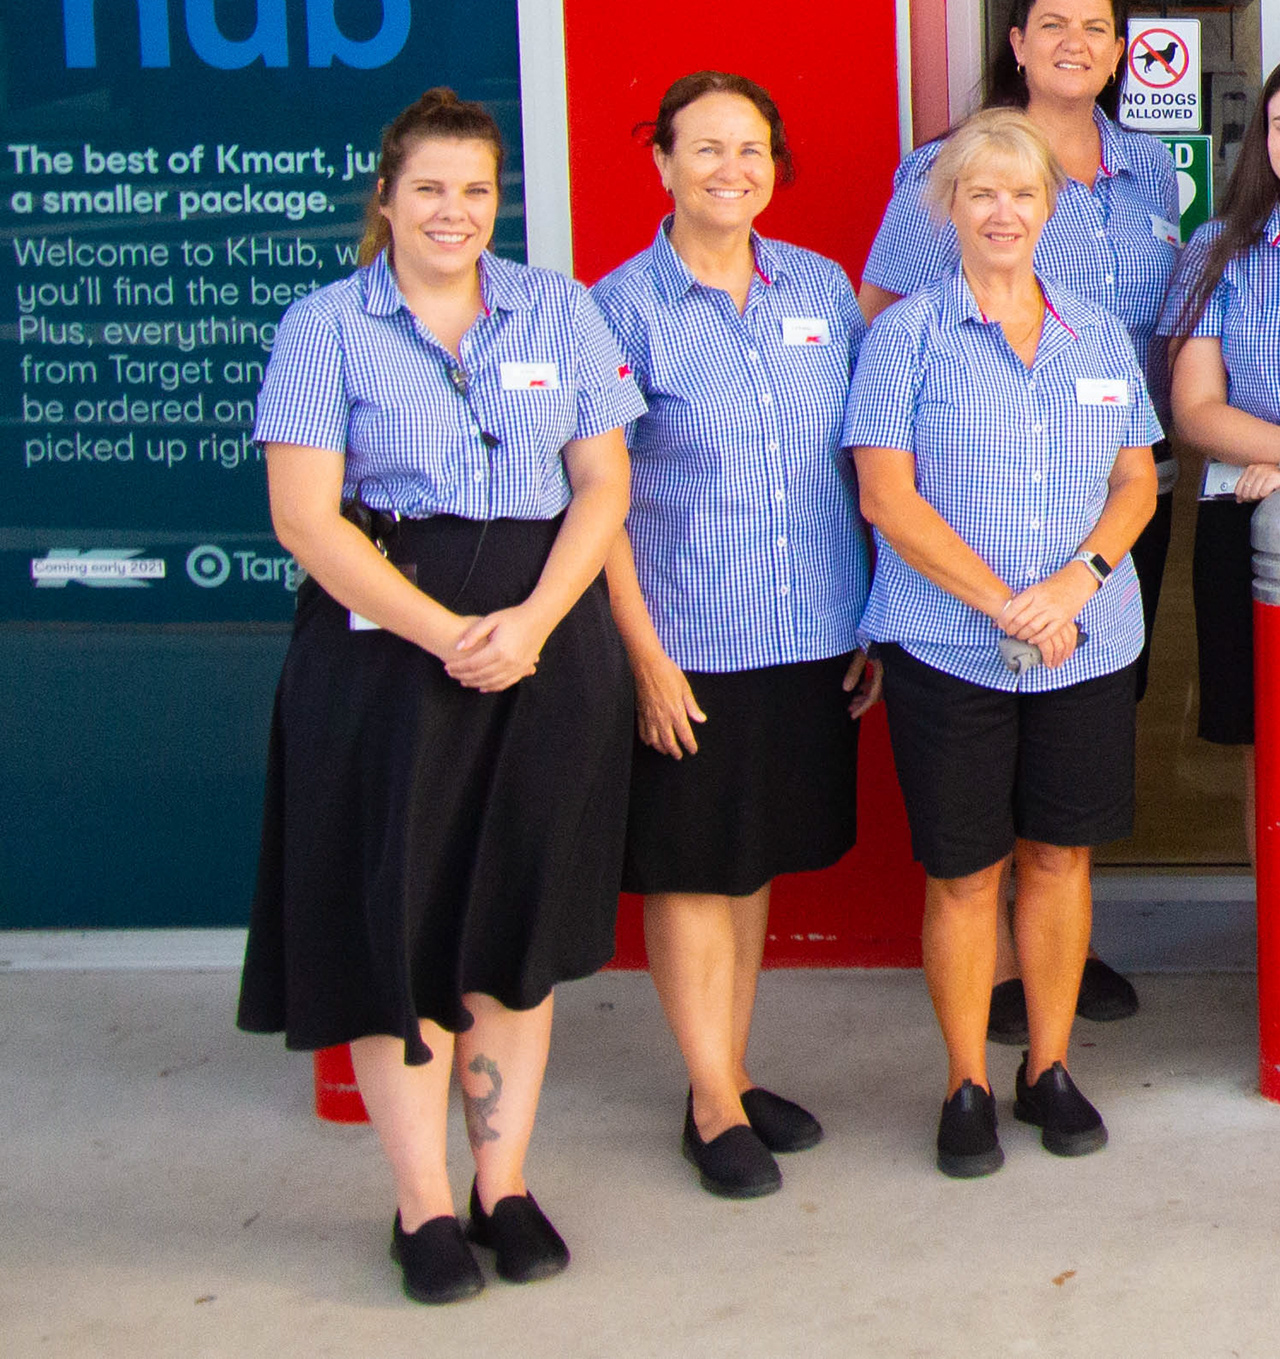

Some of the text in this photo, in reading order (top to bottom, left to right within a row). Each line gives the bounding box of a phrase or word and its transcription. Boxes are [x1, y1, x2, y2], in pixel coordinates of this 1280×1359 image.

[1122, 93, 1197, 106] NO DOGS
[1126, 108, 1193, 119] ALLOWED
[8, 144, 73, 174] The
[84, 144, 159, 174] best
[168, 144, 204, 174] of
[217, 144, 335, 178] Kmart,
[11, 185, 335, 220] a smaller package.
[13, 238, 169, 267] Welcome
[182, 240, 214, 267] to
[226, 238, 323, 270] KHub,
[17, 277, 101, 313] you’ll
[114, 277, 173, 305] find
[187, 277, 239, 305] the
[18, 316, 279, 352] Plus, everything
[20, 355, 97, 383] from
[108, 354, 213, 390] Target
[23, 393, 64, 423] be
[74, 393, 204, 423] ordered
[25, 432, 134, 468] picked
[146, 440, 187, 468] up
[34, 560, 163, 576] Coming early 2021
